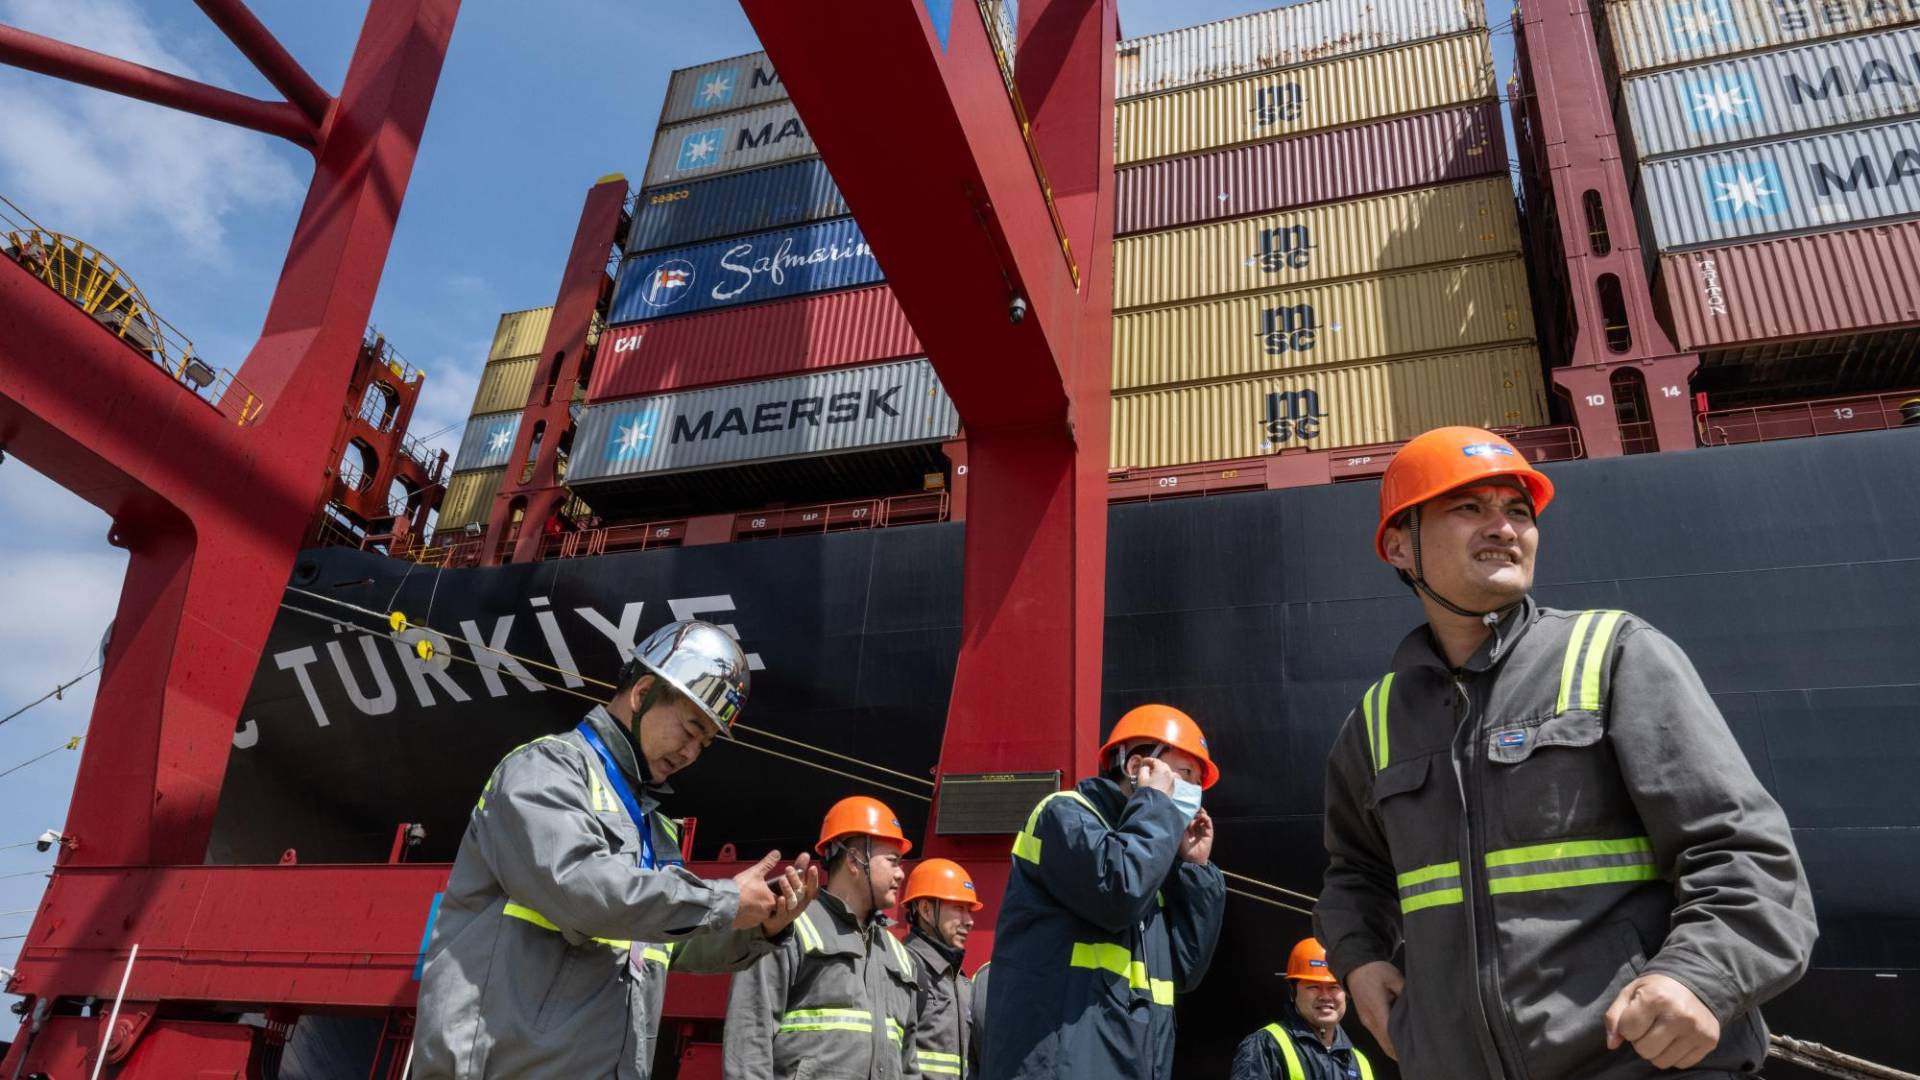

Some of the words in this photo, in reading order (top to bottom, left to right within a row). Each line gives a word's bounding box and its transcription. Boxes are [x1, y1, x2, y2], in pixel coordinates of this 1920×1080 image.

[614, 334, 642, 353] CAI
[1661, 385, 1682, 398] 14
[1585, 394, 1605, 407] 10
[670, 385, 902, 444] MAERSK
[1833, 408, 1853, 420] 13
[1159, 477, 1177, 487] 09
[852, 508, 868, 519] 07
[655, 528, 671, 538] 05
